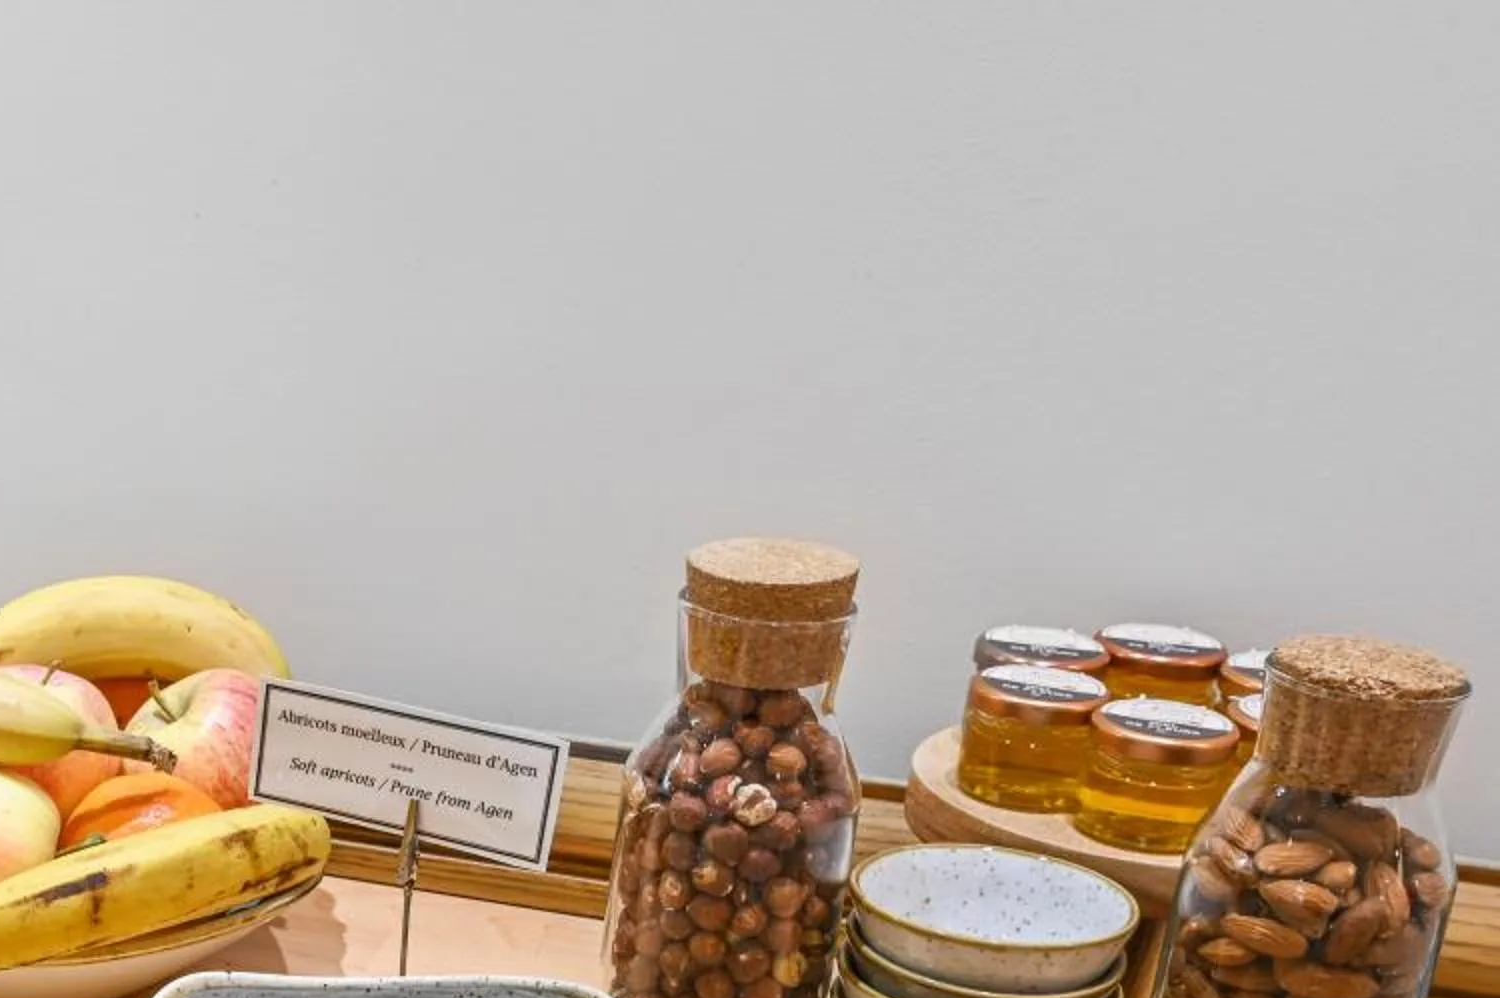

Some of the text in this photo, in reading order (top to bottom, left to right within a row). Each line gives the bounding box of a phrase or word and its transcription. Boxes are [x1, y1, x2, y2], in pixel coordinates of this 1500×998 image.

[278, 709, 337, 733] Abricots
[342, 724, 406, 749] moelleux
[409, 738, 419, 751] /
[422, 739, 482, 766] Pruneau
[289, 757, 514, 821] Soft apricots / Prune from Agen
